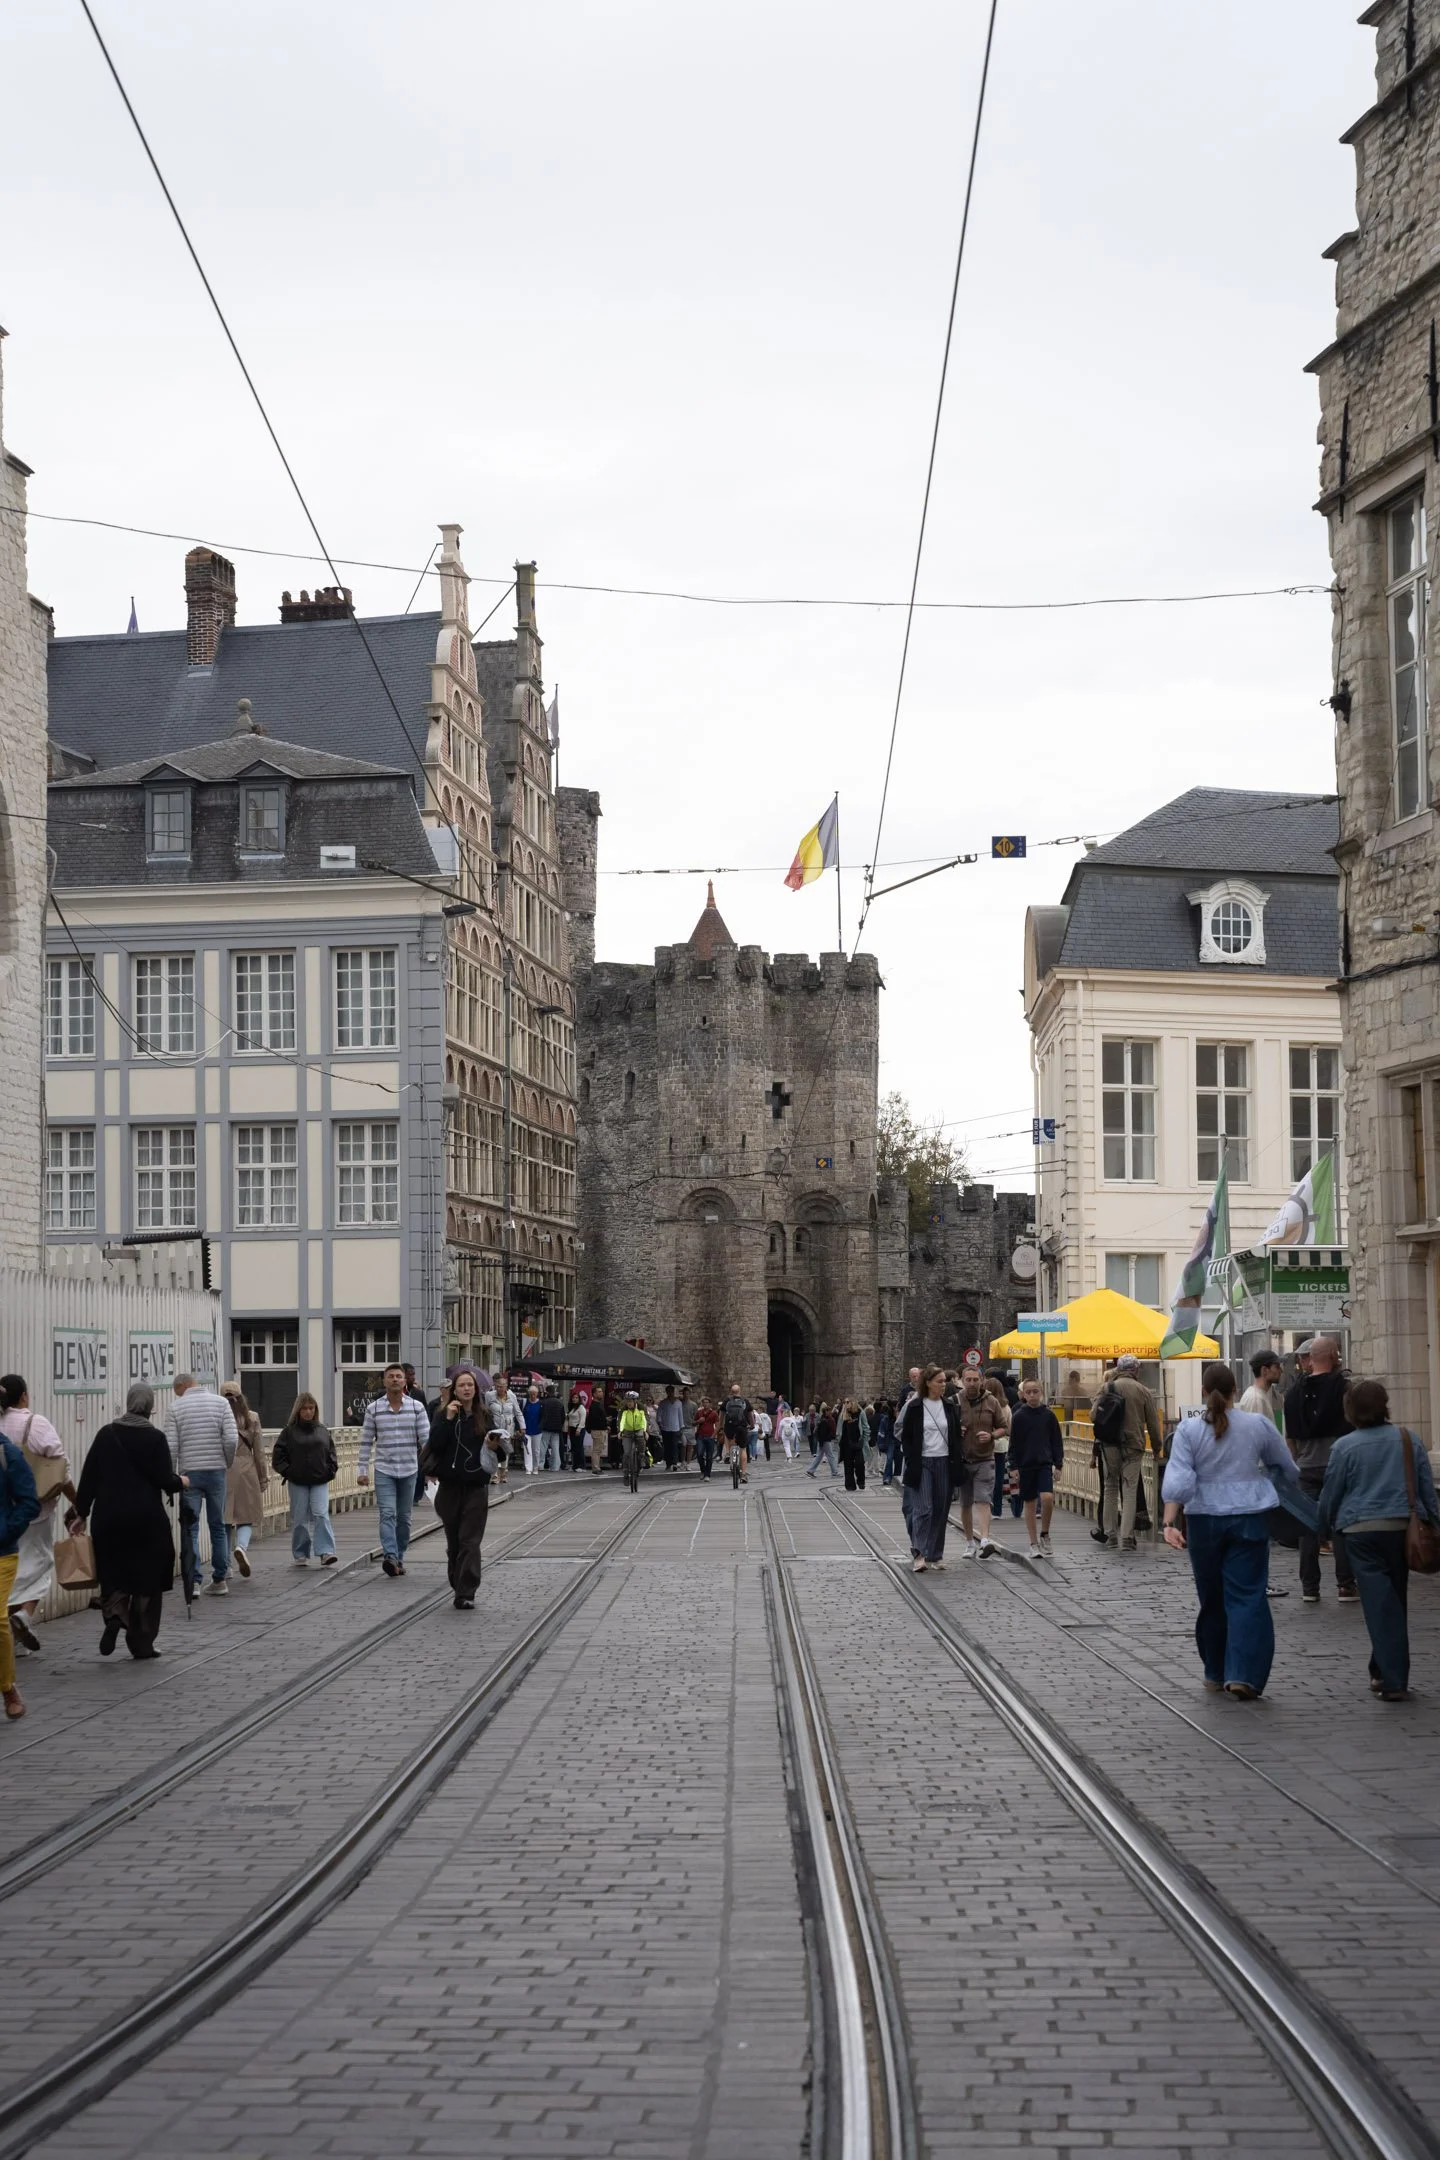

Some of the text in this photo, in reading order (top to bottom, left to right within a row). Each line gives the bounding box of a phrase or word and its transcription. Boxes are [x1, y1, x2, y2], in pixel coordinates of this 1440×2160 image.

[999, 841, 1010, 853] 10
[1298, 1283, 1347, 1292] TICKETS
[1076, 1345, 1158, 1356] Tickets Boattrips
[54, 1341, 106, 1379] DENYS
[130, 1343, 173, 1377] DENYS
